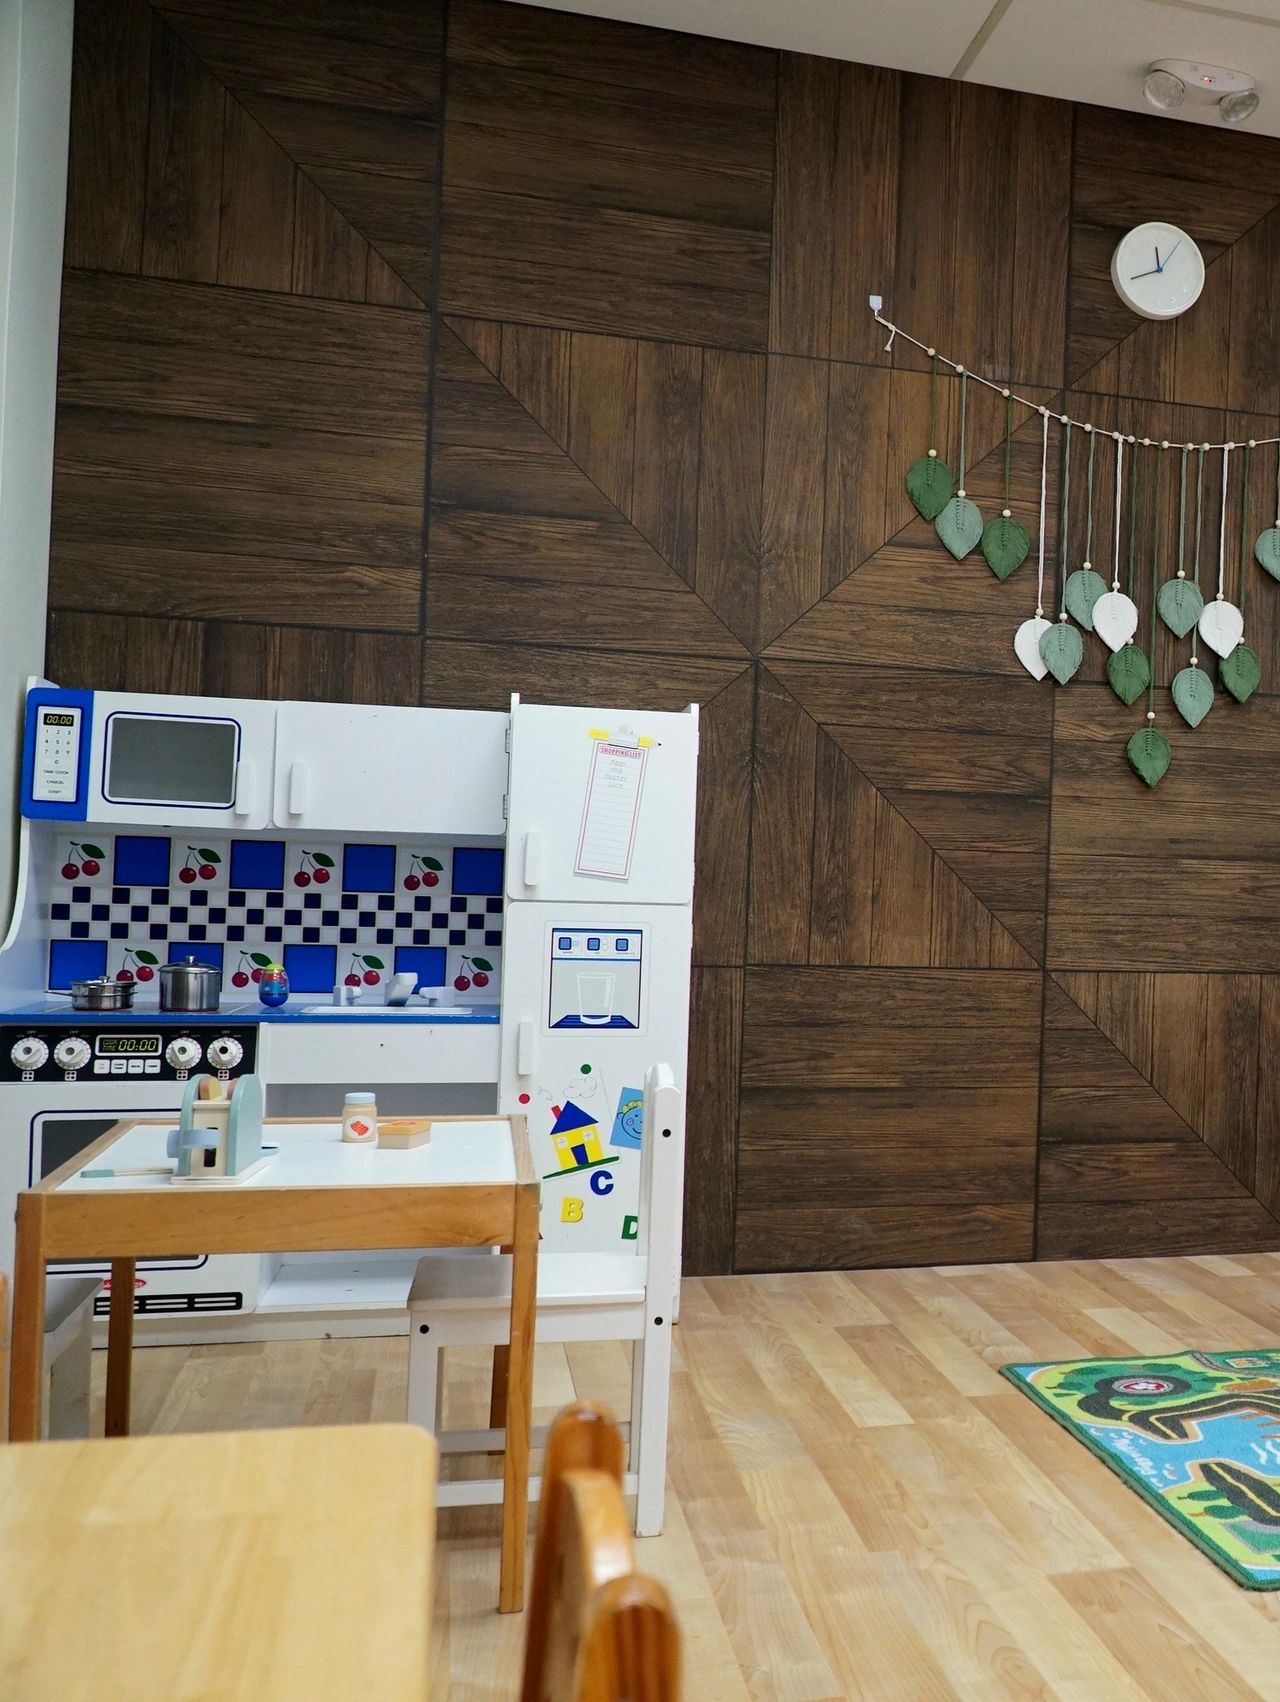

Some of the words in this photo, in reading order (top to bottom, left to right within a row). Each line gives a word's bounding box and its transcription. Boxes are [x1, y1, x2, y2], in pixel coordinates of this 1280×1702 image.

[46, 715, 72, 724] 00:00
[119, 1040, 157, 1050] 00:00
[590, 1170, 614, 1196] C
[560, 1197, 584, 1223] B
